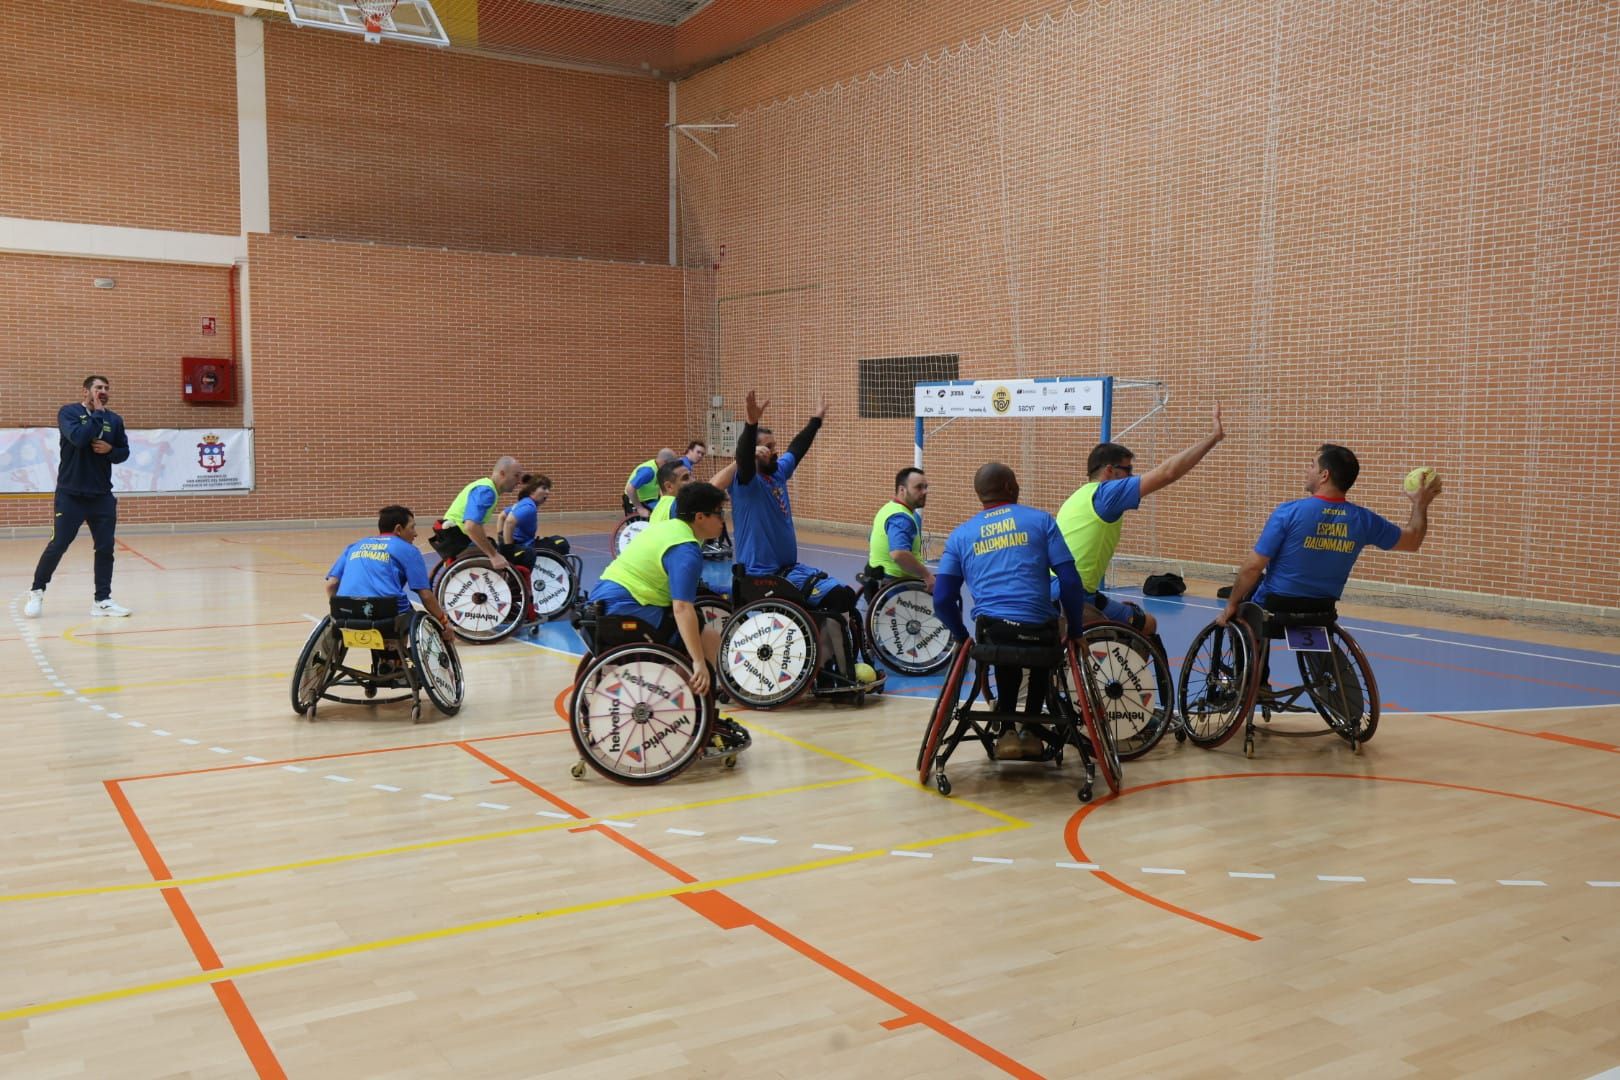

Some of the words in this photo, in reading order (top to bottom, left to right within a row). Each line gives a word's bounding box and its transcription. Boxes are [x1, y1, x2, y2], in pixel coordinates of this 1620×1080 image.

[448, 580, 473, 607] helvetia
[482, 571, 500, 602] helvetia
[464, 611, 498, 622] helvetia
[896, 597, 932, 616] helvetia
[734, 625, 772, 648] helvetia
[781, 627, 796, 670] helvetia
[889, 618, 904, 656] helvetia
[1302, 631, 1314, 646] 3
[622, 668, 671, 699] helvetia
[743, 660, 775, 692] helvetia
[1112, 646, 1143, 692] helvetia
[608, 698, 621, 753] helvetia
[641, 715, 690, 750] helvetia
[1106, 711, 1145, 723] helveti
